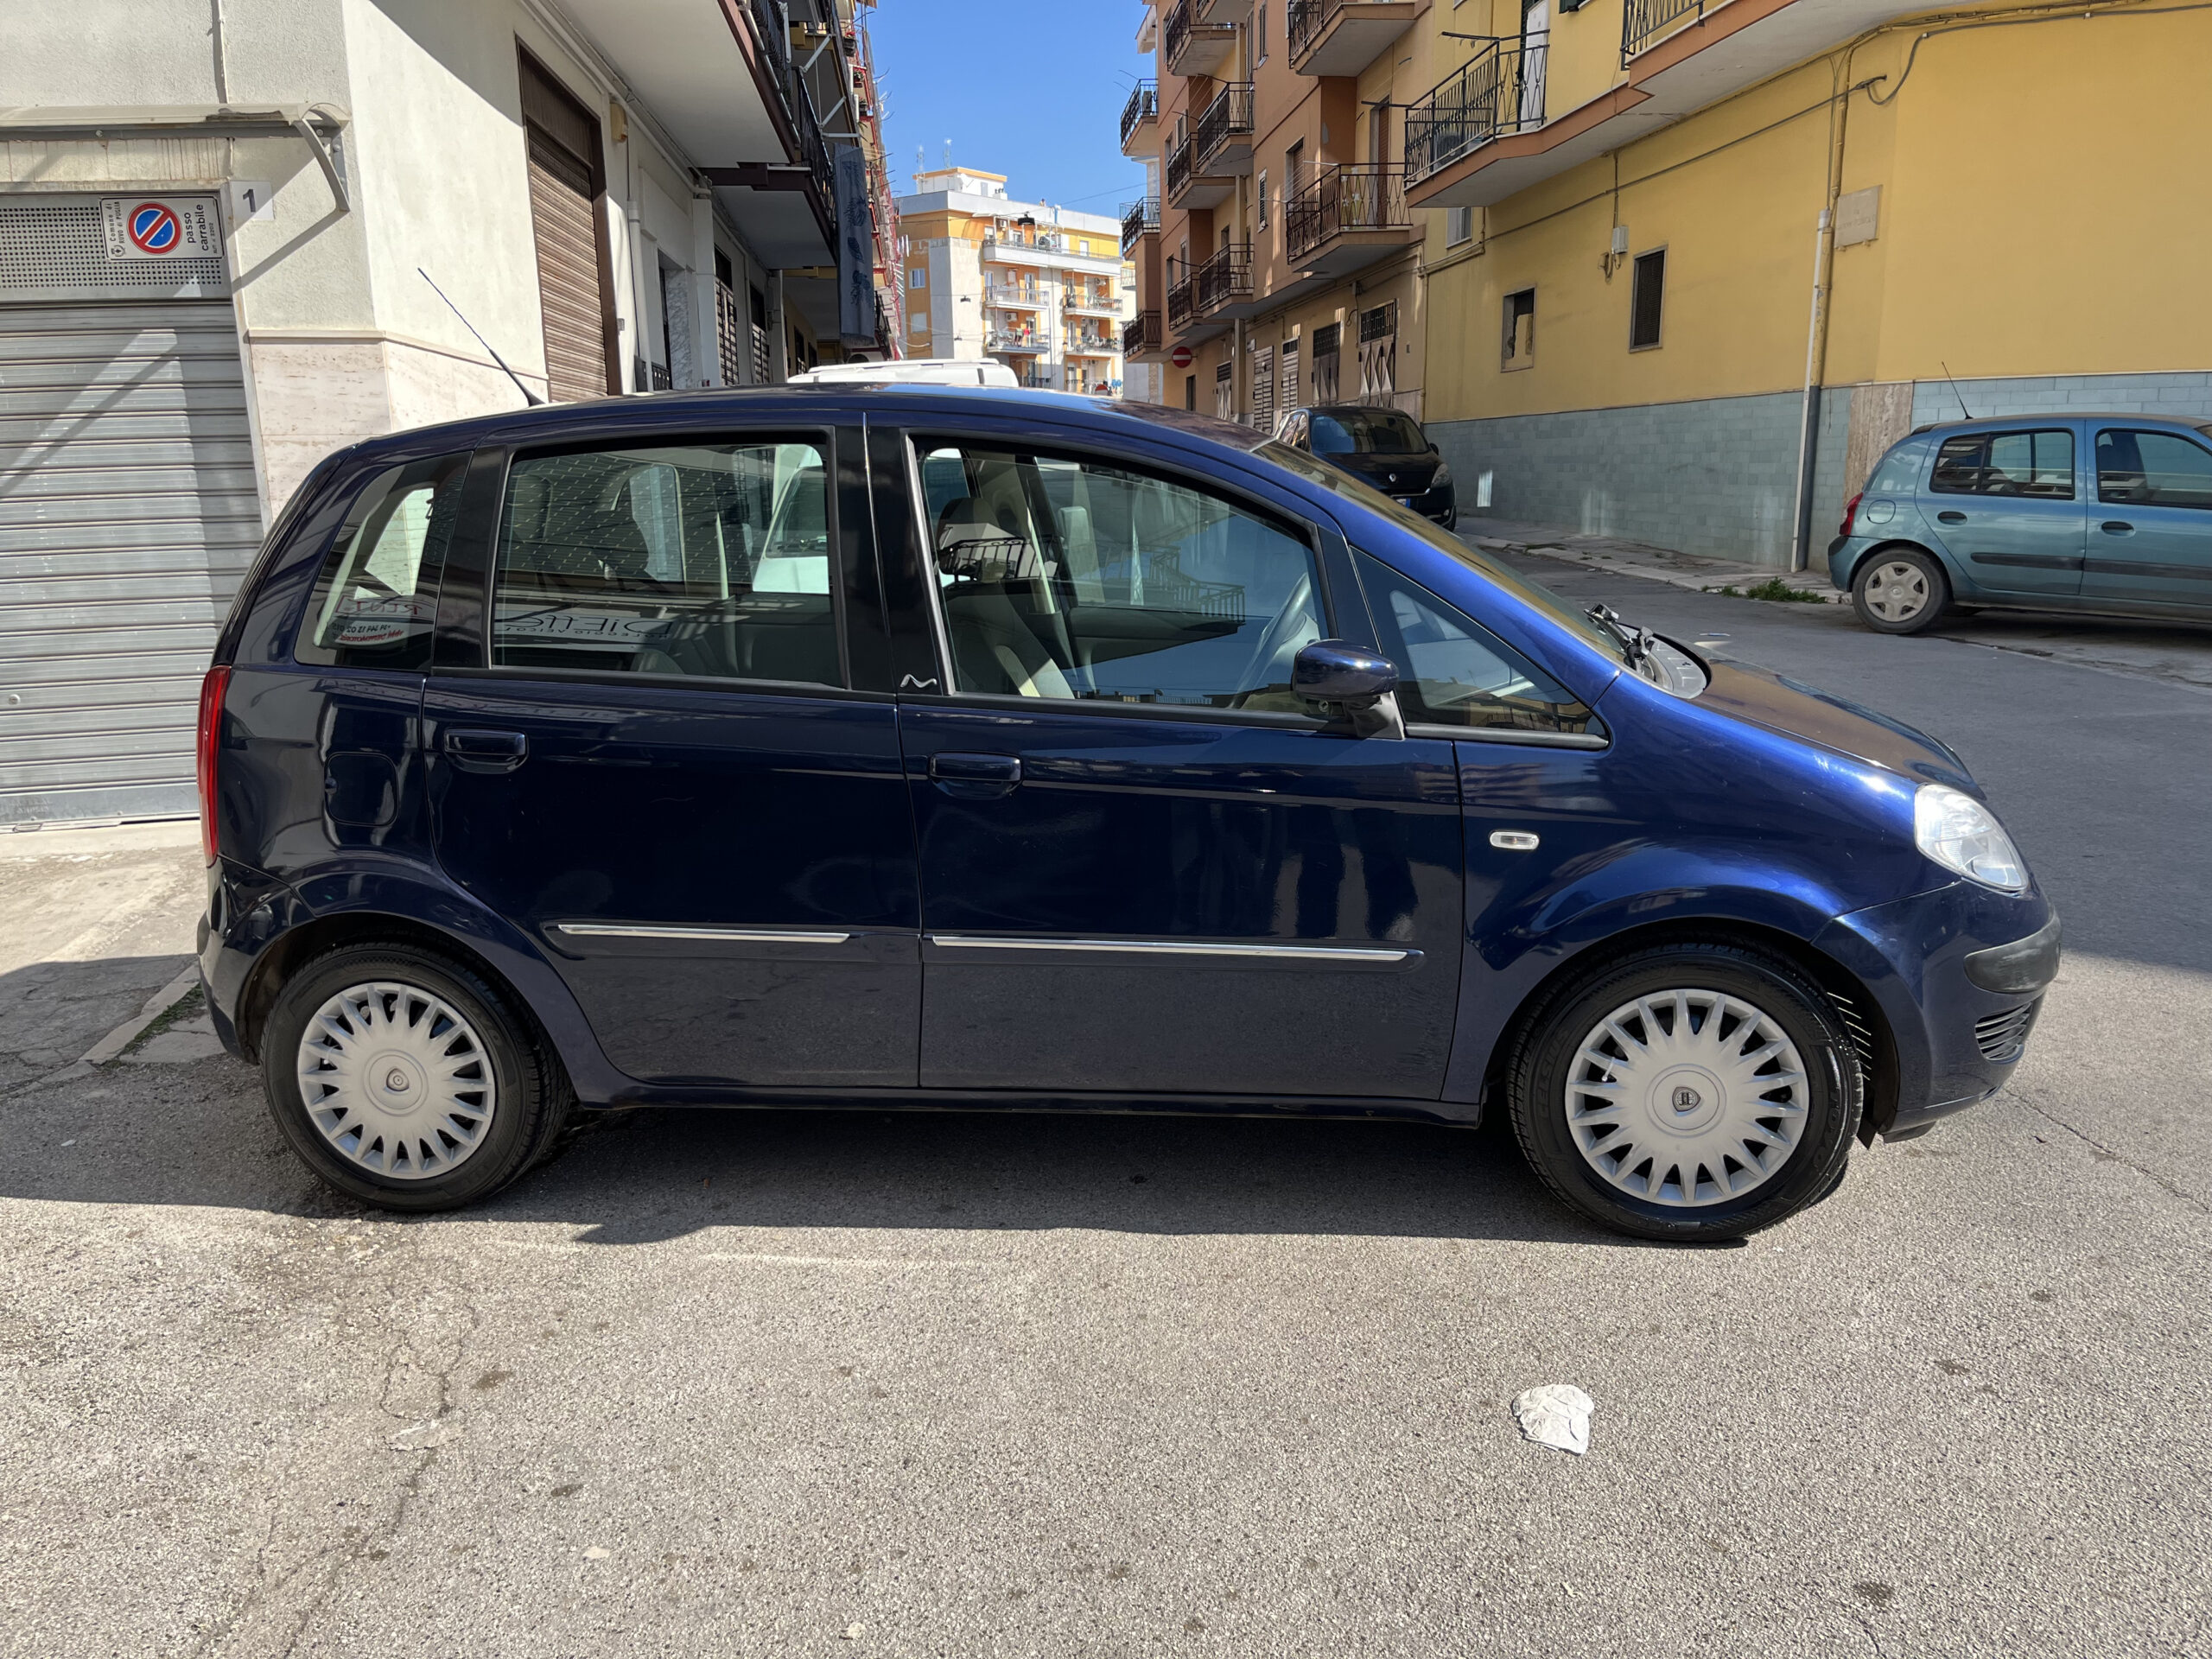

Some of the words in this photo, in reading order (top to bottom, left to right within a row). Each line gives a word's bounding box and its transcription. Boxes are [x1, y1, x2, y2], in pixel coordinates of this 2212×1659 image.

[114, 201, 123, 219] PUGLIA
[243, 188, 256, 213] 1
[183, 212, 196, 244] passo
[195, 204, 209, 251] carrabile
